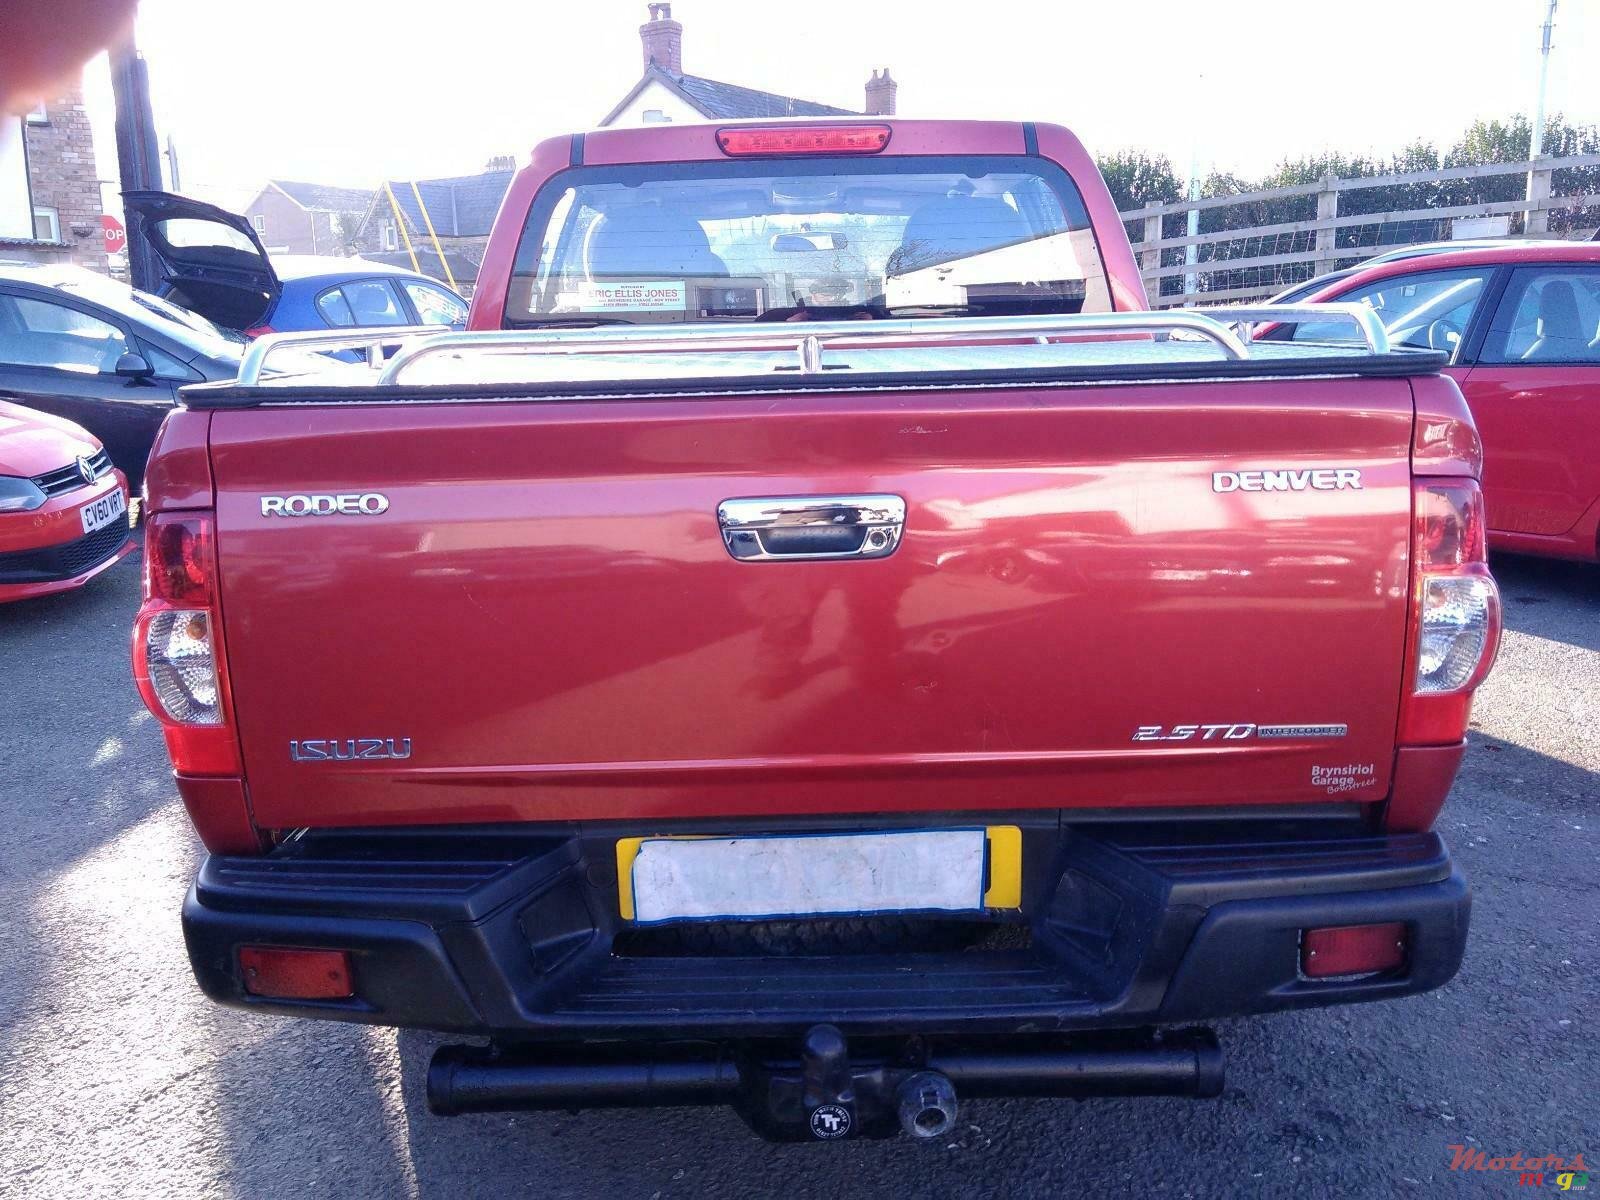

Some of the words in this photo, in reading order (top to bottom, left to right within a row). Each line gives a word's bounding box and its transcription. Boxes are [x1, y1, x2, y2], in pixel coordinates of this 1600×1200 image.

[103, 229, 124, 240] OP
[615, 289, 642, 298] ELLIS
[645, 289, 678, 298] JONES
[1212, 469, 1363, 493] DENVER
[85, 500, 109, 527] CV60
[108, 491, 122, 514] VRT
[260, 493, 390, 517] RODEO
[1259, 726, 1346, 737] INTERCOOLER
[290, 738, 411, 761] ISUZU
[1311, 763, 1375, 778] Brynsiriol
[1311, 775, 1354, 787] Garage
